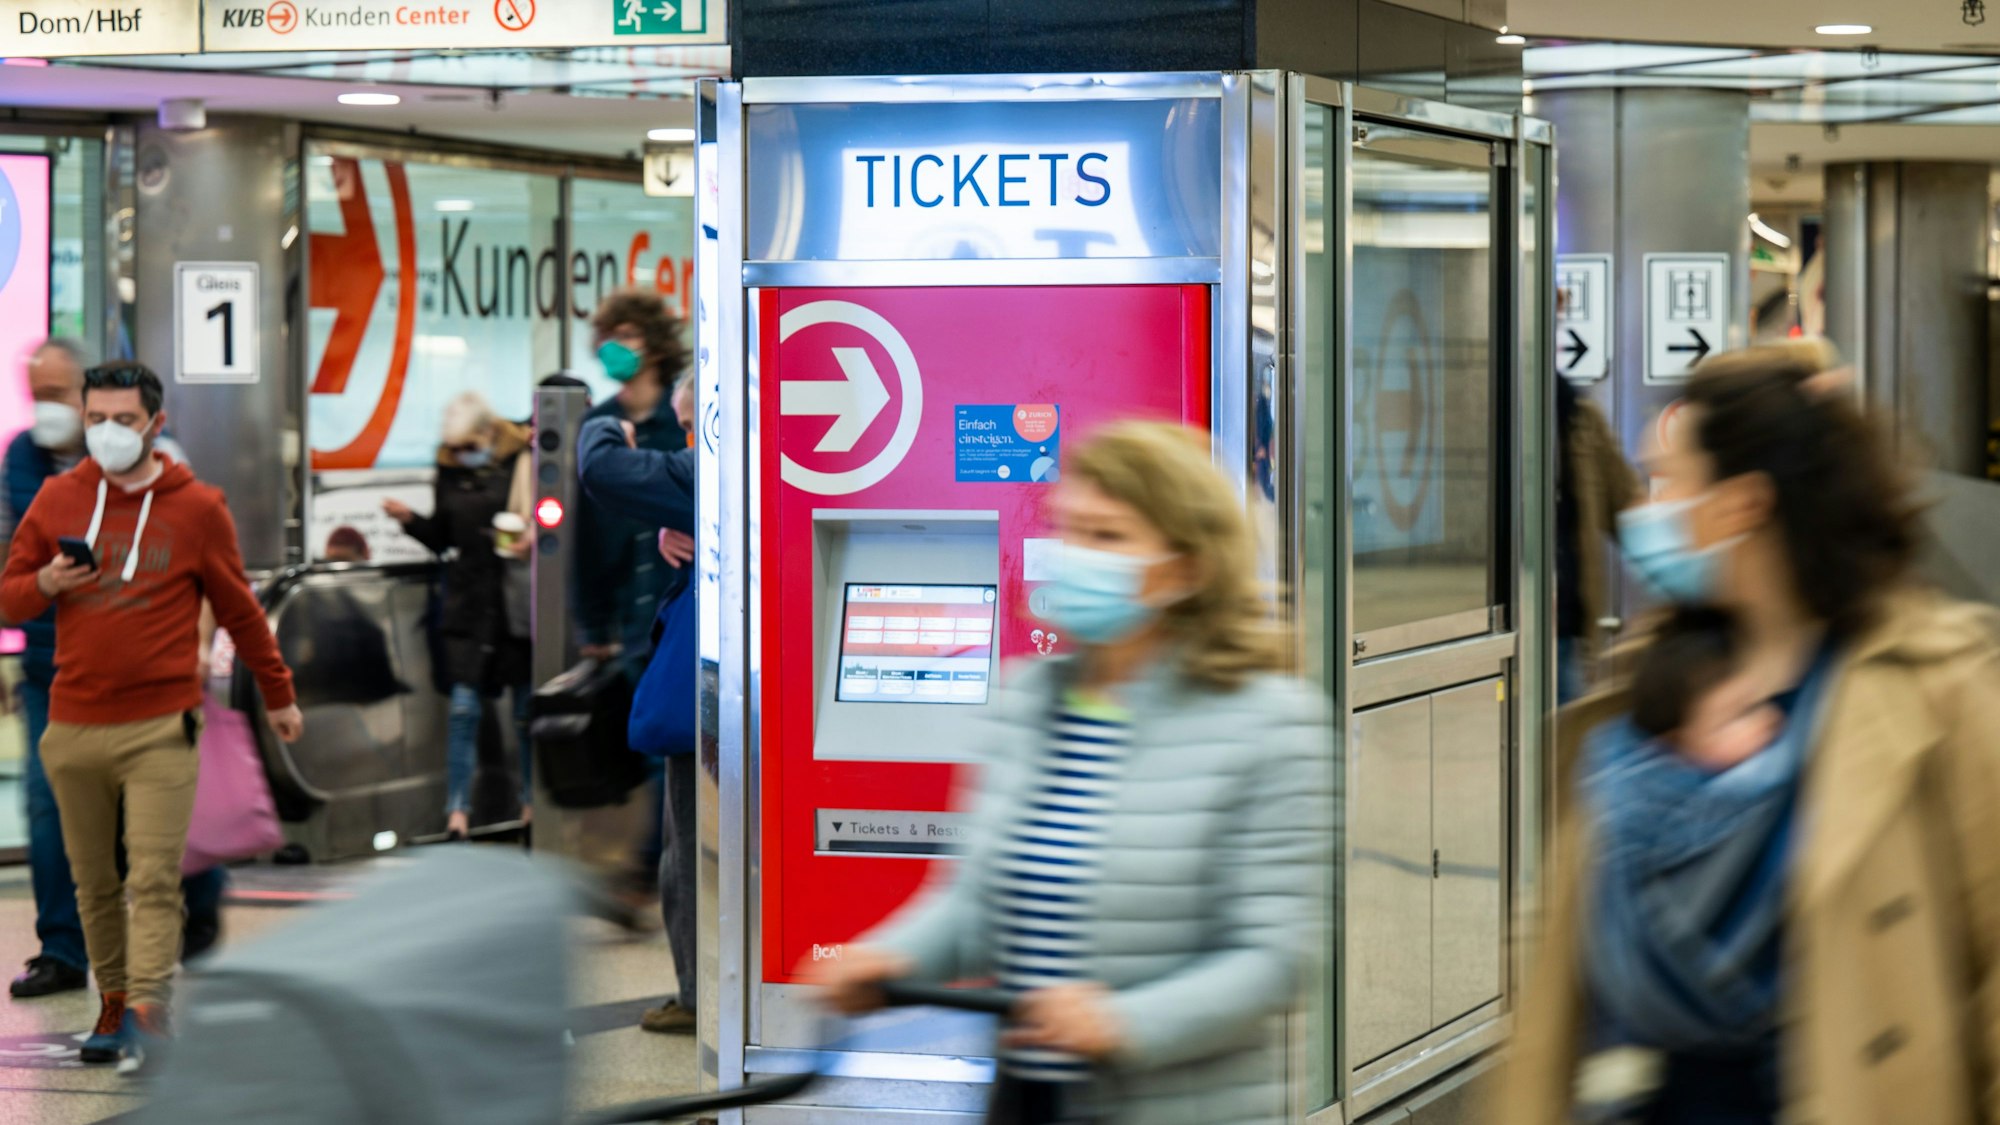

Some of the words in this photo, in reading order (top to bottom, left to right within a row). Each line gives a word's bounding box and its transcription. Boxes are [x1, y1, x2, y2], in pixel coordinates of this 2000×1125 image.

[19, 8, 142, 34] Dom/Hbf
[222, 8, 265, 28] KVB
[306, 6, 391, 26] Kunden
[395, 6, 470, 25] Center
[855, 152, 1111, 208] TICKETS
[441, 217, 619, 321] Kunden
[196, 274, 240, 292] Gleis
[206, 301, 232, 366] 1
[959, 419, 996, 430] Einfach
[959, 433, 1014, 448] einsteigen.
[850, 822, 899, 836] Tickets
[910, 824, 917, 836] &
